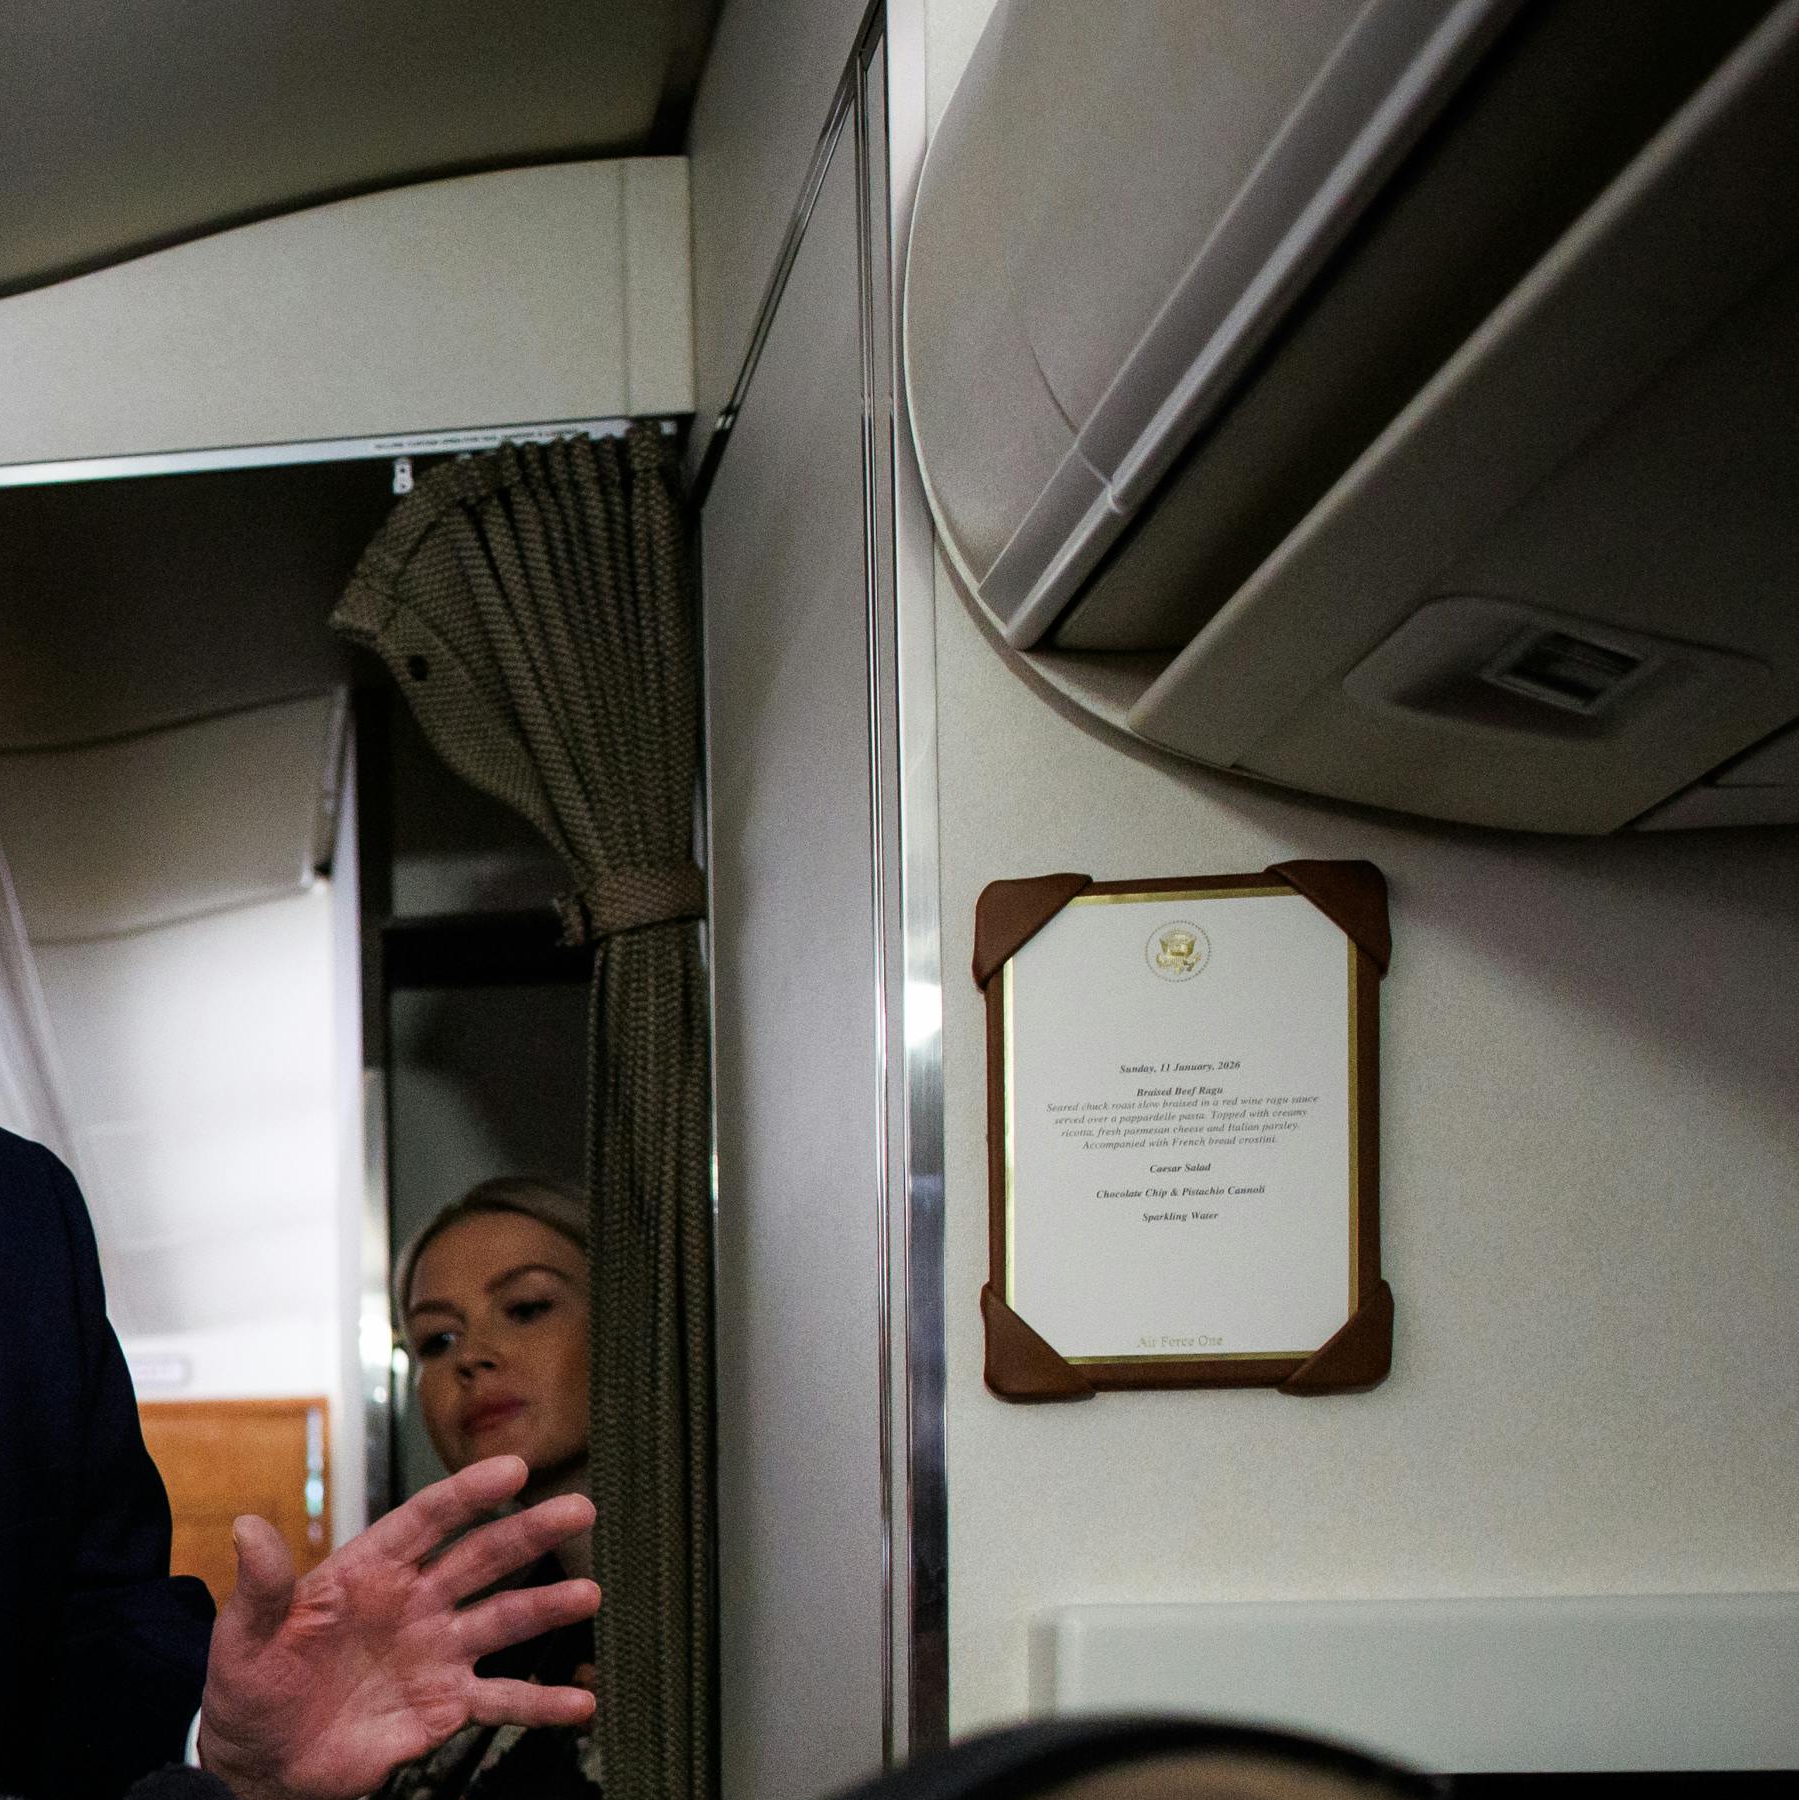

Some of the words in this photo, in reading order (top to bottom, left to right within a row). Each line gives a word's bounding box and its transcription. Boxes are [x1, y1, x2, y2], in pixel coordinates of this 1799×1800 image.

[1218, 1061, 1241, 1070] 2026
[1136, 1088, 1172, 1096] Braised
[1174, 1086, 1197, 1096] Beef
[1198, 1086, 1223, 1096] Ragu
[1222, 1098, 1238, 1106] red
[1210, 1110, 1246, 1120] Topped
[1249, 1110, 1270, 1118] with
[1272, 1110, 1308, 1118] creamy
[1096, 1128, 1121, 1138] fresh
[1124, 1126, 1170, 1136] parmesan
[1206, 1124, 1225, 1132] and
[1082, 1140, 1146, 1150] Accompanied
[1148, 1138, 1168, 1147] with
[1172, 1136, 1206, 1146] French
[1149, 1164, 1182, 1173] Caesar
[1184, 1163, 1212, 1172] Salad
[1096, 1189, 1142, 1198] Chocolate
[1145, 1188, 1168, 1198] Chip
[1170, 1188, 1178, 1196] &
[1181, 1187, 1224, 1196] Pistachio
[1227, 1185, 1266, 1195] Cannoli
[1142, 1212, 1188, 1222] Sparkling
[1191, 1212, 1219, 1220] Water
[1198, 1335, 1224, 1346] One
